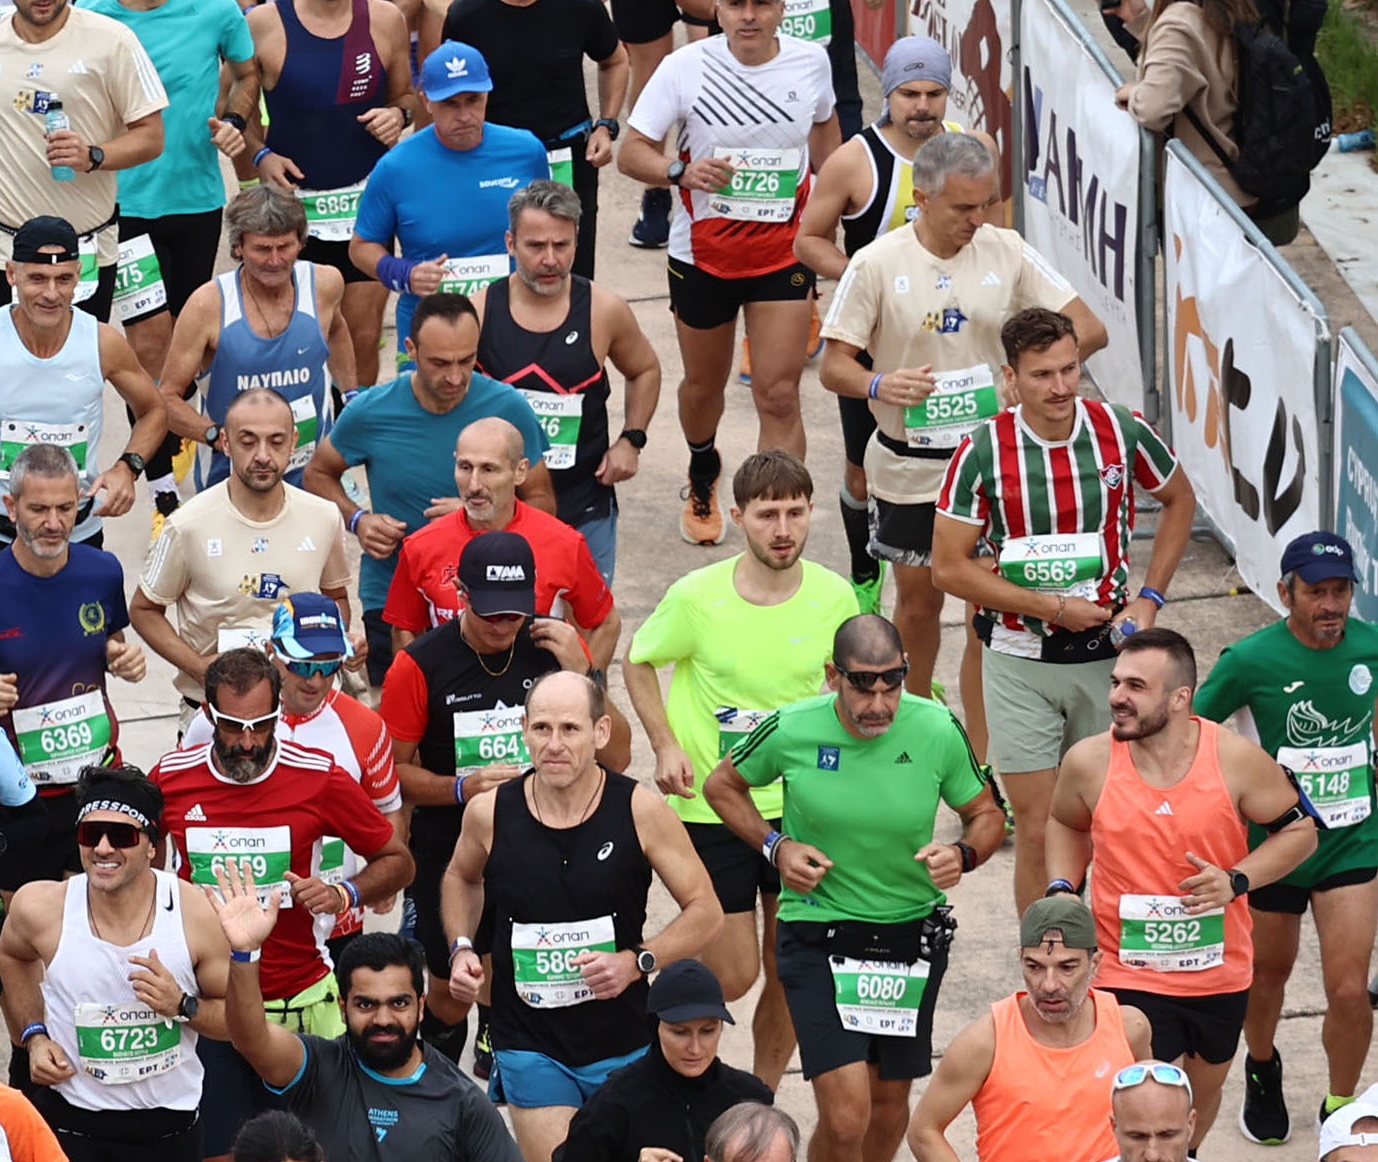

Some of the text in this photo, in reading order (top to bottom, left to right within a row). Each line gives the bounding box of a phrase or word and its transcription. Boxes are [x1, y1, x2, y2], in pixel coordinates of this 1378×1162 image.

[732, 171, 779, 193] 6726
[316, 195, 359, 214] 6867
[237, 366, 310, 388] ΝΑΥΠΛΙΟ
[926, 393, 977, 419] 5525
[1024, 560, 1076, 582] 6563
[41, 722, 93, 751] 6369
[1303, 773, 1349, 795] 5148
[1145, 920, 1200, 943] 5262
[857, 976, 905, 999] 6080
[101, 1027, 158, 1050] 6723
[368, 1109, 399, 1118] ATHENS
